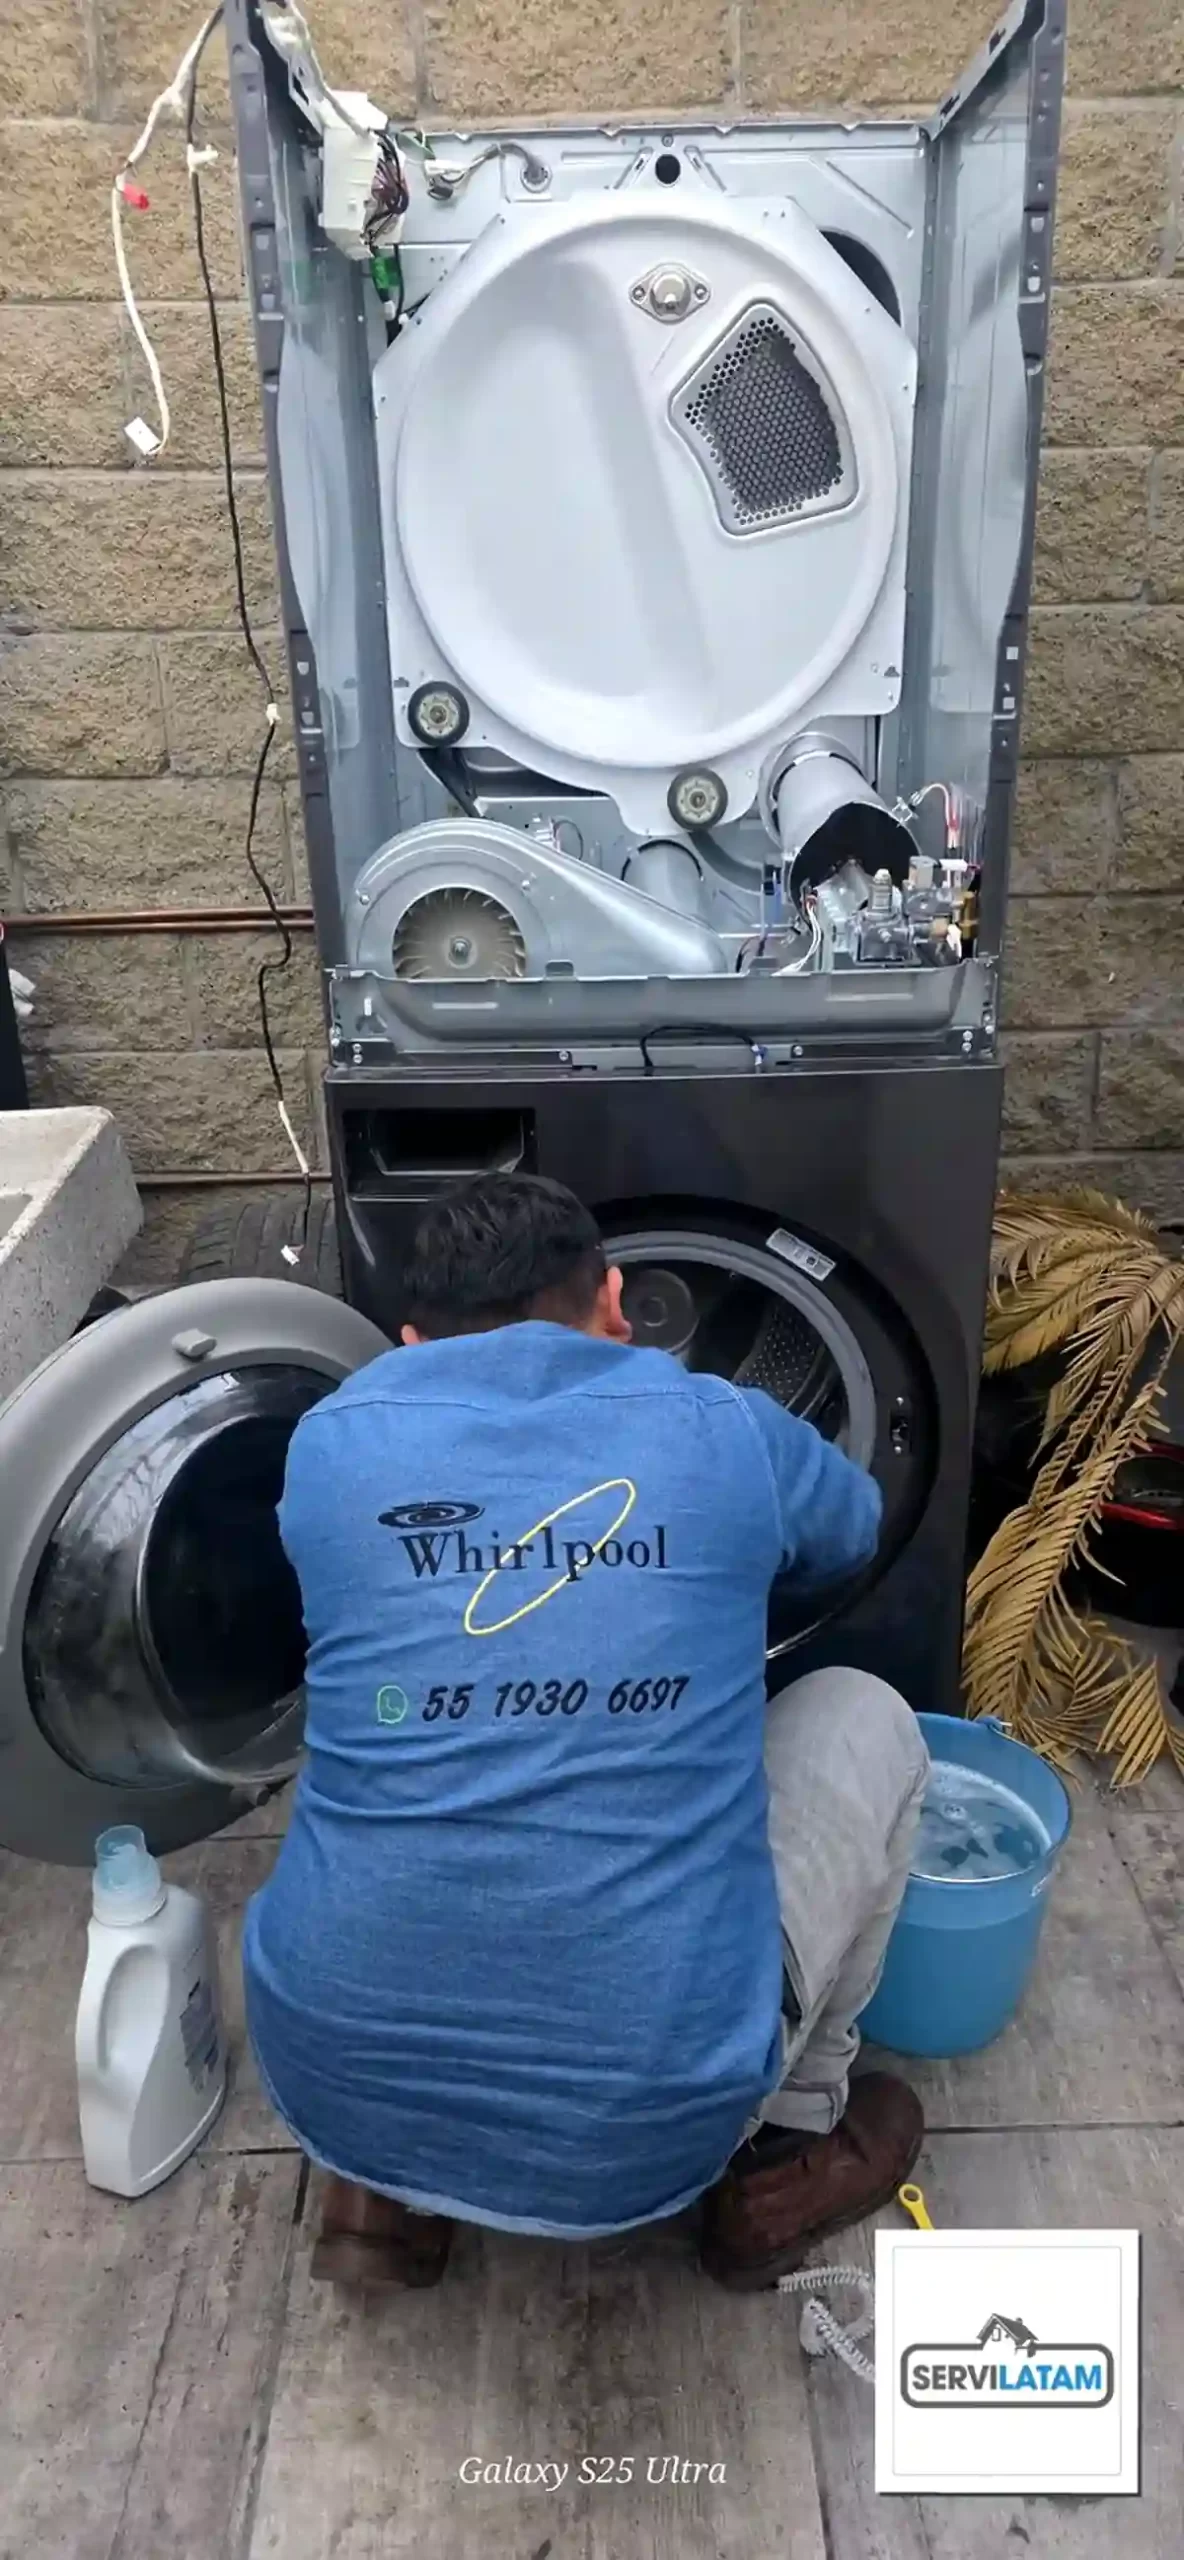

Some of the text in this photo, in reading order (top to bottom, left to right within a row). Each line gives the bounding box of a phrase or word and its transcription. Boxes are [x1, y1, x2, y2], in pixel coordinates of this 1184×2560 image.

[398, 1525, 671, 1582] Whirlpool
[421, 1675, 690, 1722] 55 1930 6697
